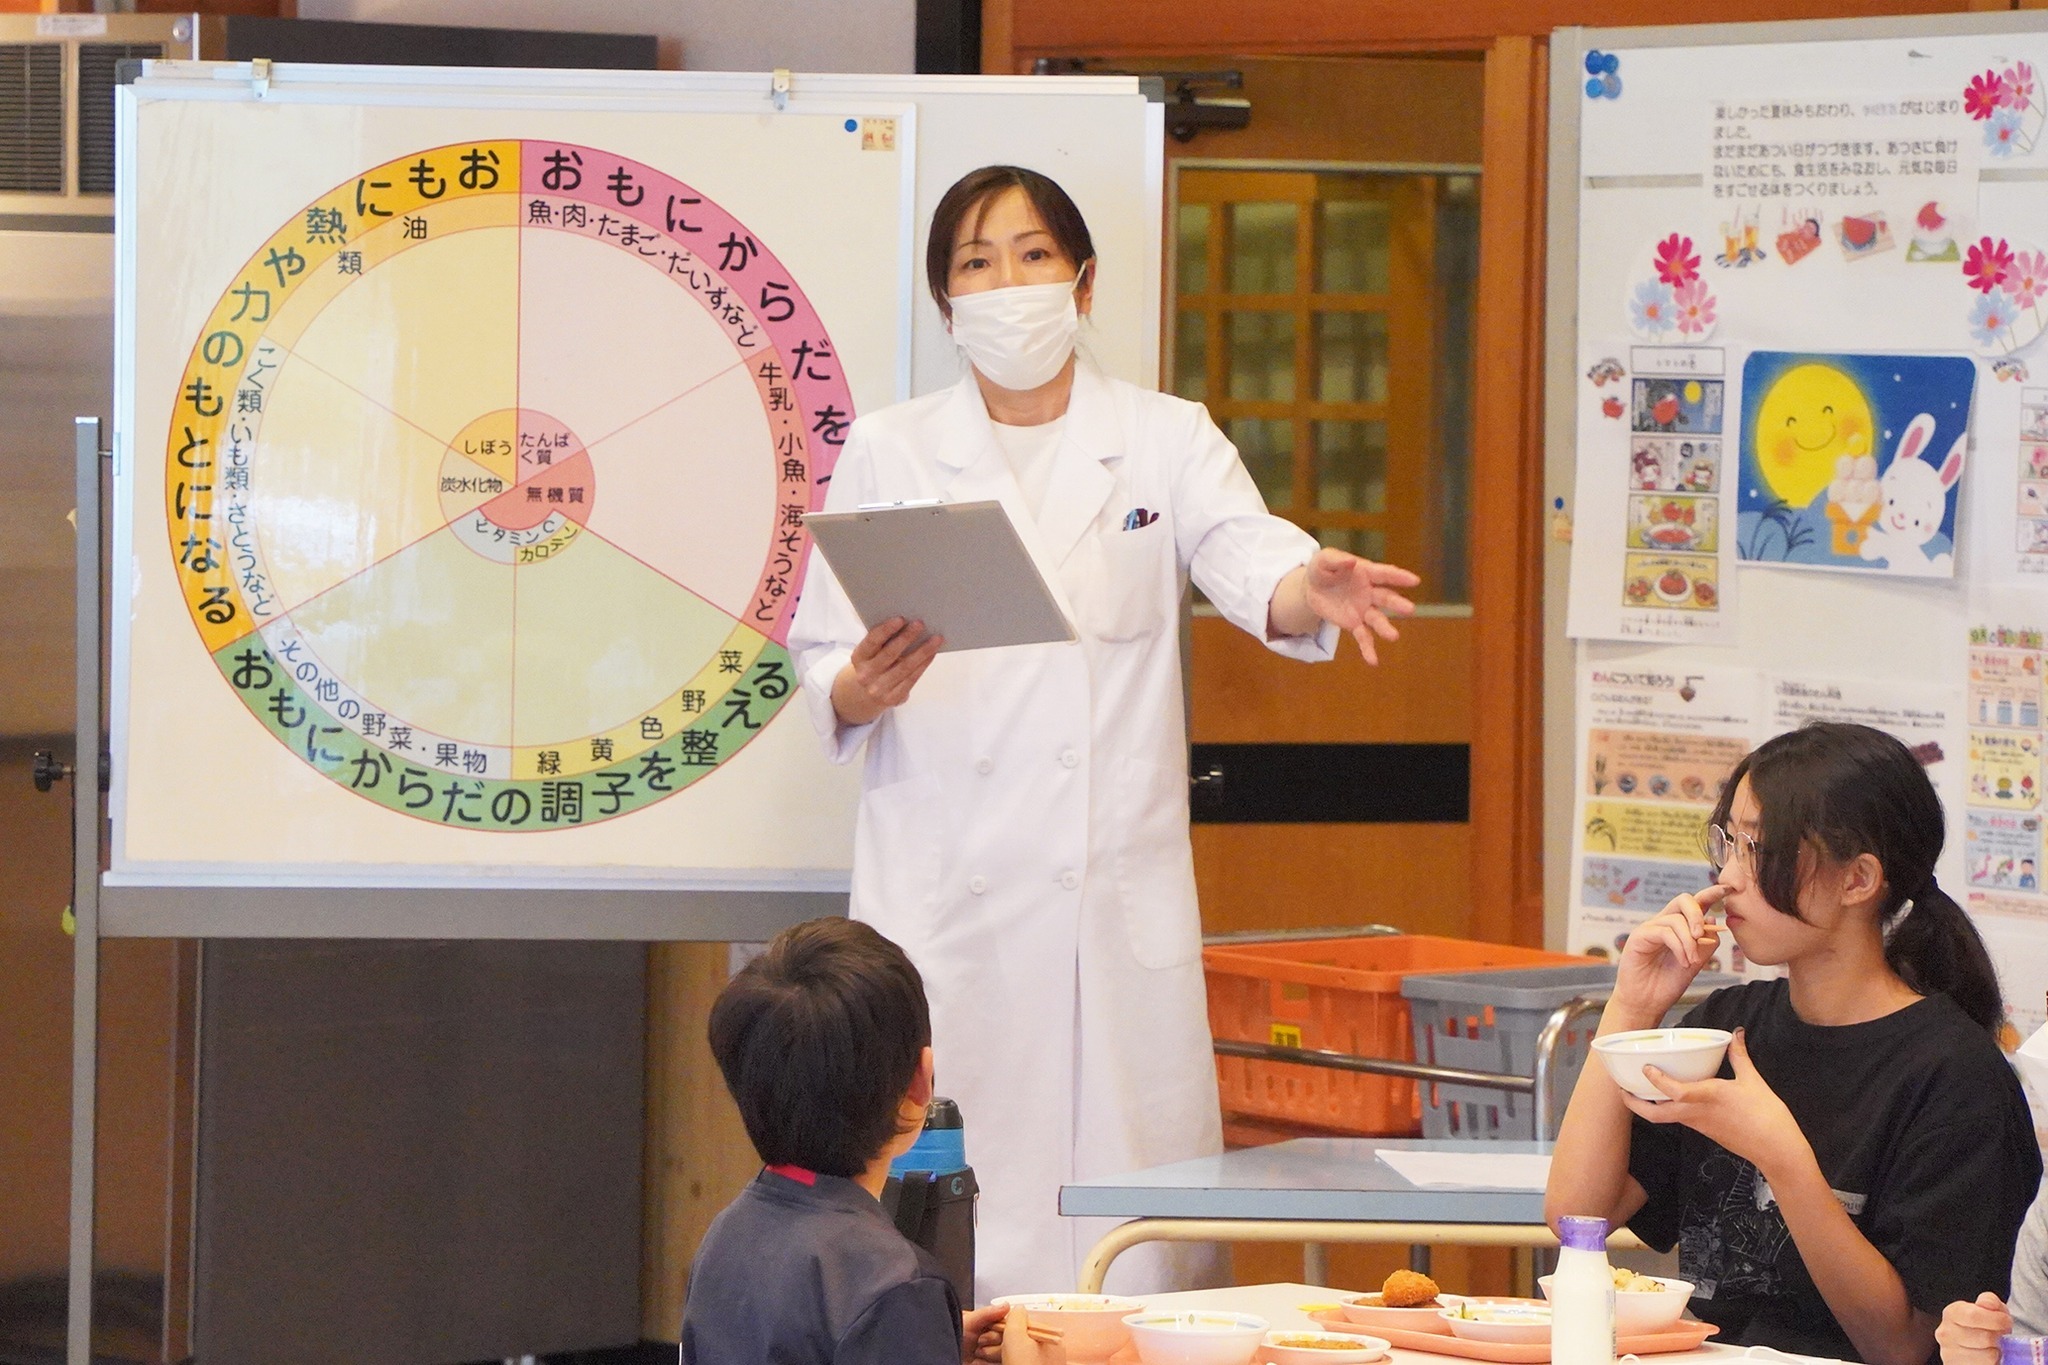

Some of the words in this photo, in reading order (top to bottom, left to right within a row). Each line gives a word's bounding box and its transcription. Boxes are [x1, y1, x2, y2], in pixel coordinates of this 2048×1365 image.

[541, 149, 850, 620] おもにからだを
[464, 439, 512, 455] しぼう
[521, 449, 552, 465] く質
[440, 477, 503, 493] 炭水化物
[526, 486, 584, 503] 無機質
[520, 526, 578, 562] カロテン
[232, 649, 790, 826] おもにからだの調子を整える
